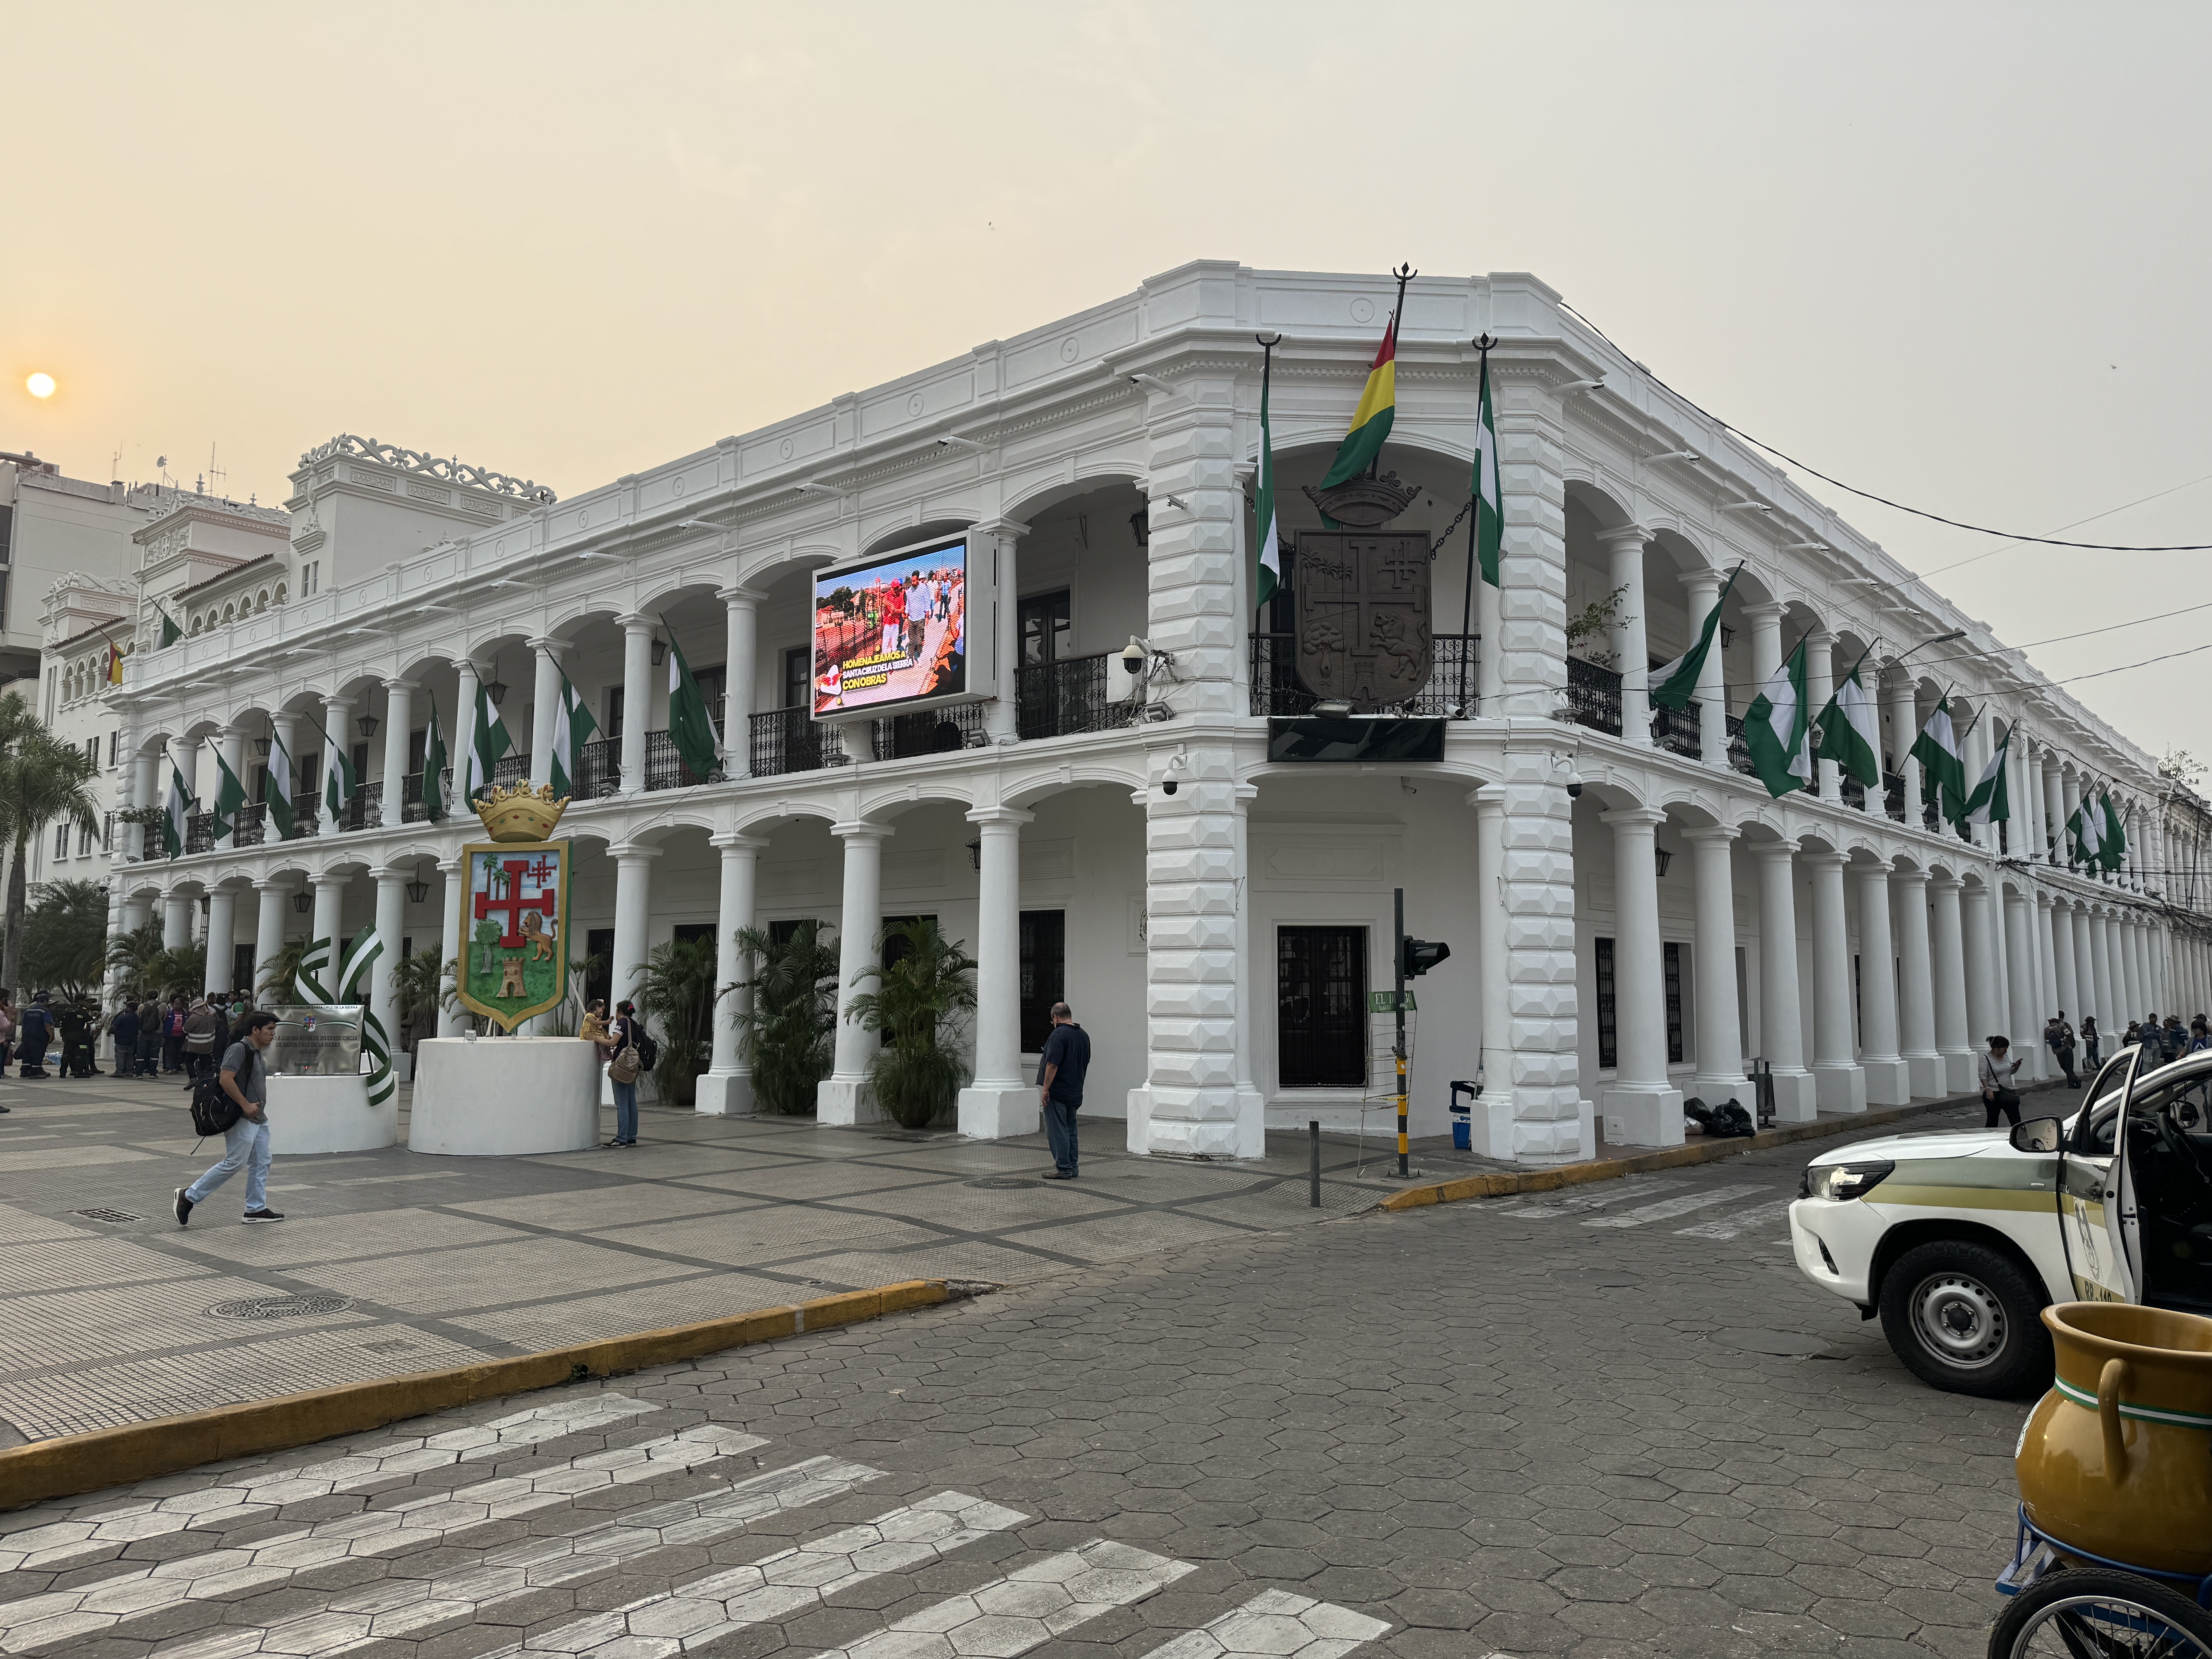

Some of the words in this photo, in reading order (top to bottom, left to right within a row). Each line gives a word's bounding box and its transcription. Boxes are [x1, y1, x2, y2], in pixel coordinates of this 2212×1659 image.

[842, 668, 862, 678] SANTA
[862, 665, 878, 675] CRUZ
[877, 664, 884, 673] DE
[884, 662, 892, 672] LA
[891, 658, 913, 669] SIERRA
[843, 650, 900, 669] HOMENAJEAMOS
[901, 650, 906, 658] A
[842, 678, 860, 690] CON
[860, 673, 887, 687] OBRAS
[1376, 993, 1385, 1004] EL
